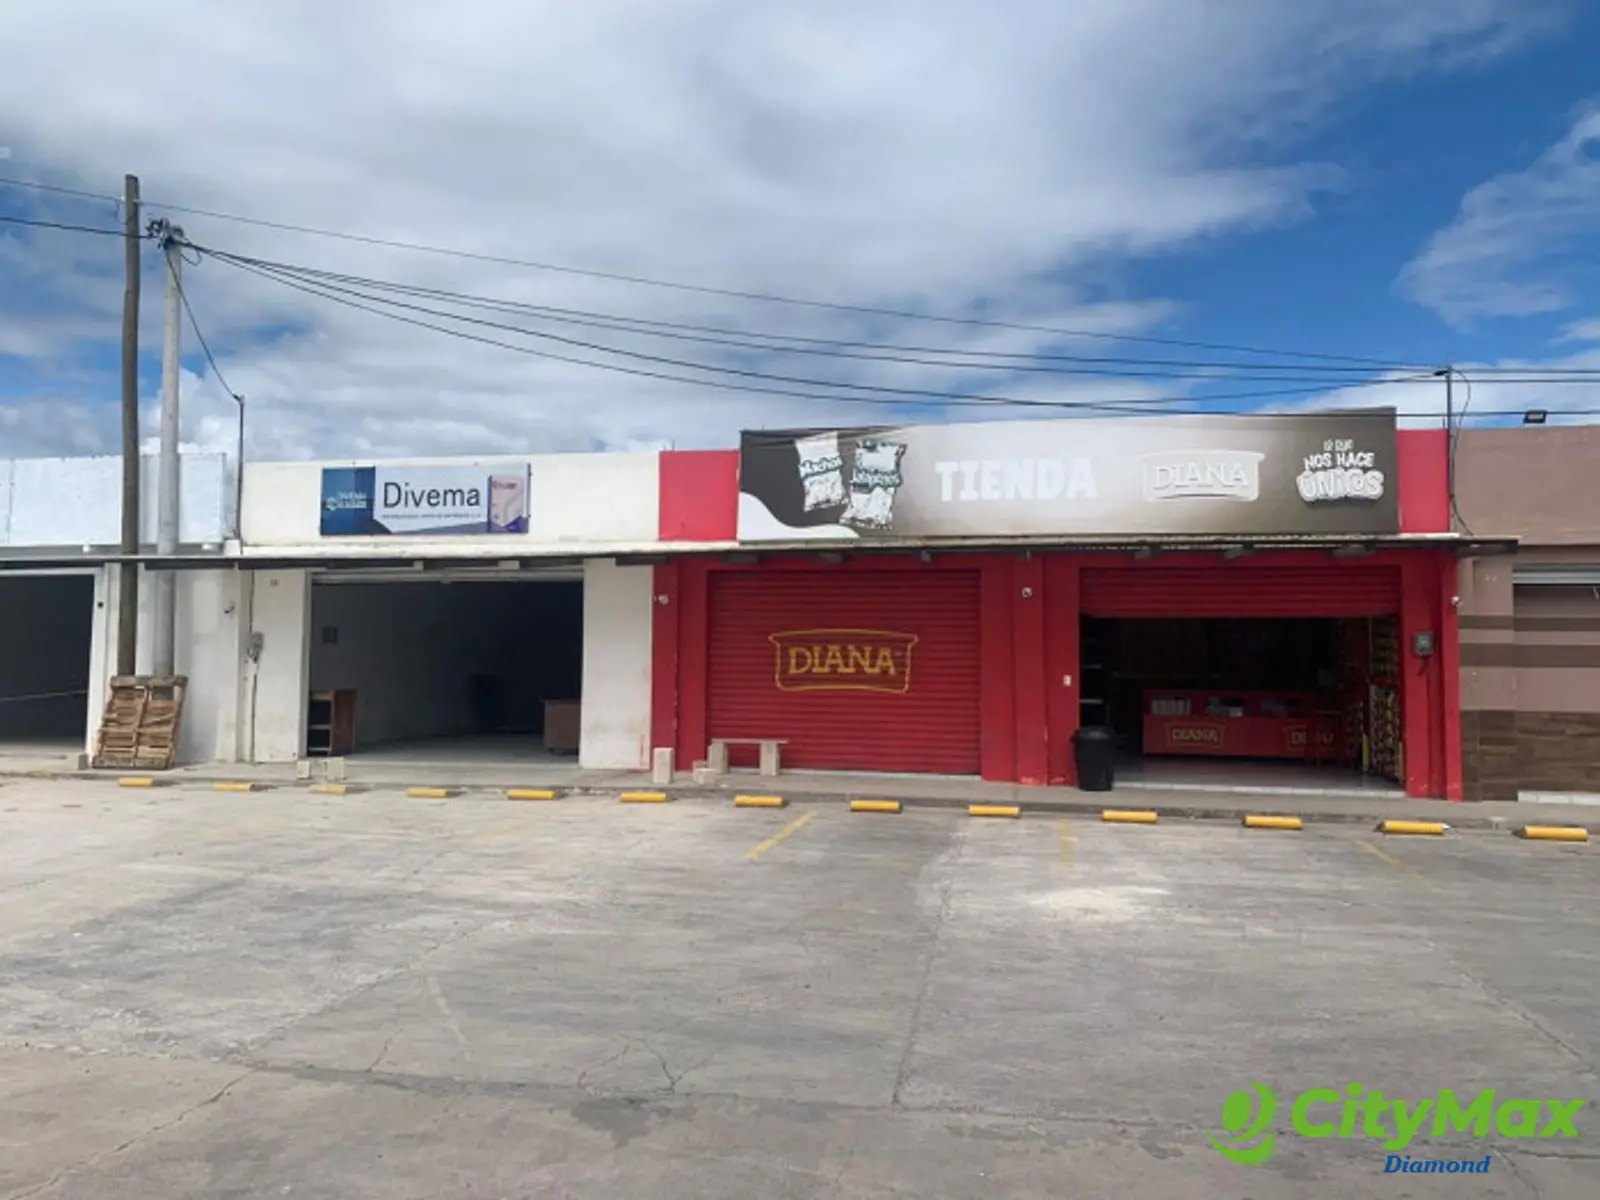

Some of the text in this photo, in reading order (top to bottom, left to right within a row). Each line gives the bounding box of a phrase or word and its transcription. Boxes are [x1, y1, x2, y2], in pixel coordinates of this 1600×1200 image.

[1303, 451, 1375, 471] NOS HACE
[935, 457, 1099, 502] TIENDA
[1152, 461, 1249, 489] DIANA
[383, 482, 481, 508] Divema
[788, 645, 897, 676] DIANA
[1171, 727, 1219, 743] DIANA
